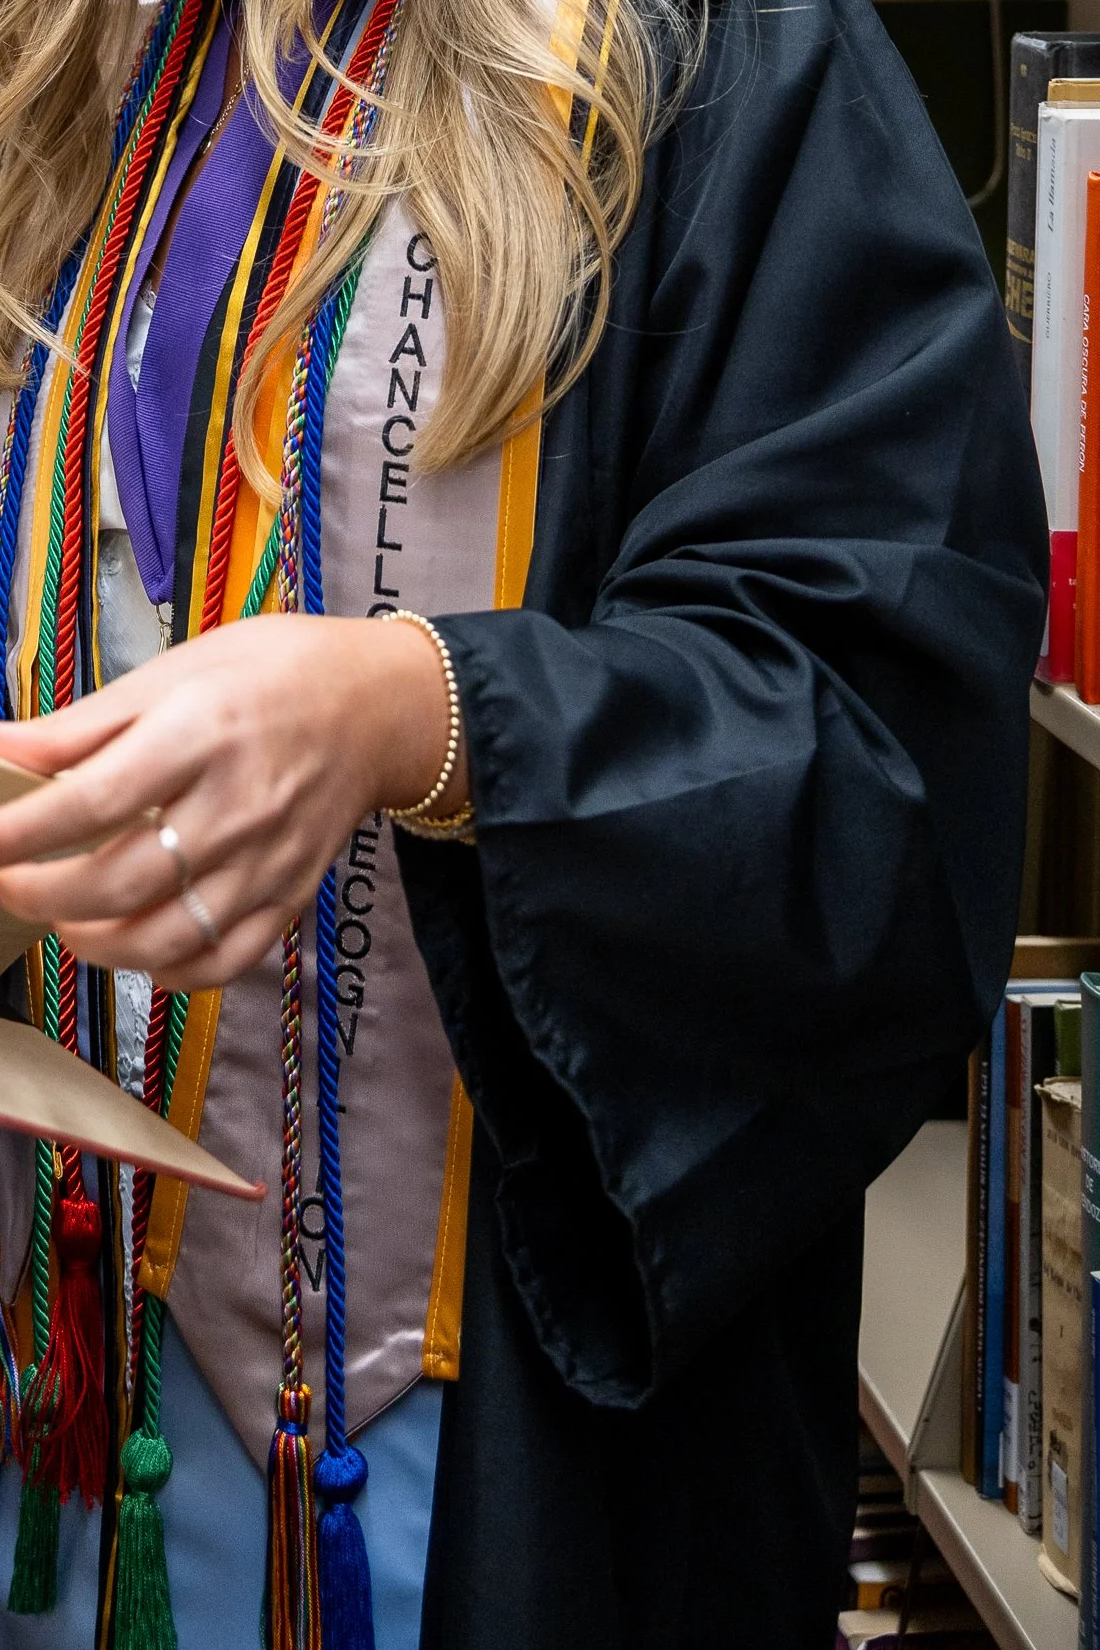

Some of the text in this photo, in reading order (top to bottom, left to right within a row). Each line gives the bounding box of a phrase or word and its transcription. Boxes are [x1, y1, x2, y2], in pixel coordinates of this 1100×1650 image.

[1047, 137, 1056, 207] llamada
[1082, 293, 1090, 331] CARA
[1081, 336, 1089, 396] OSCURA
[1085, 1173, 1094, 1193] DE
